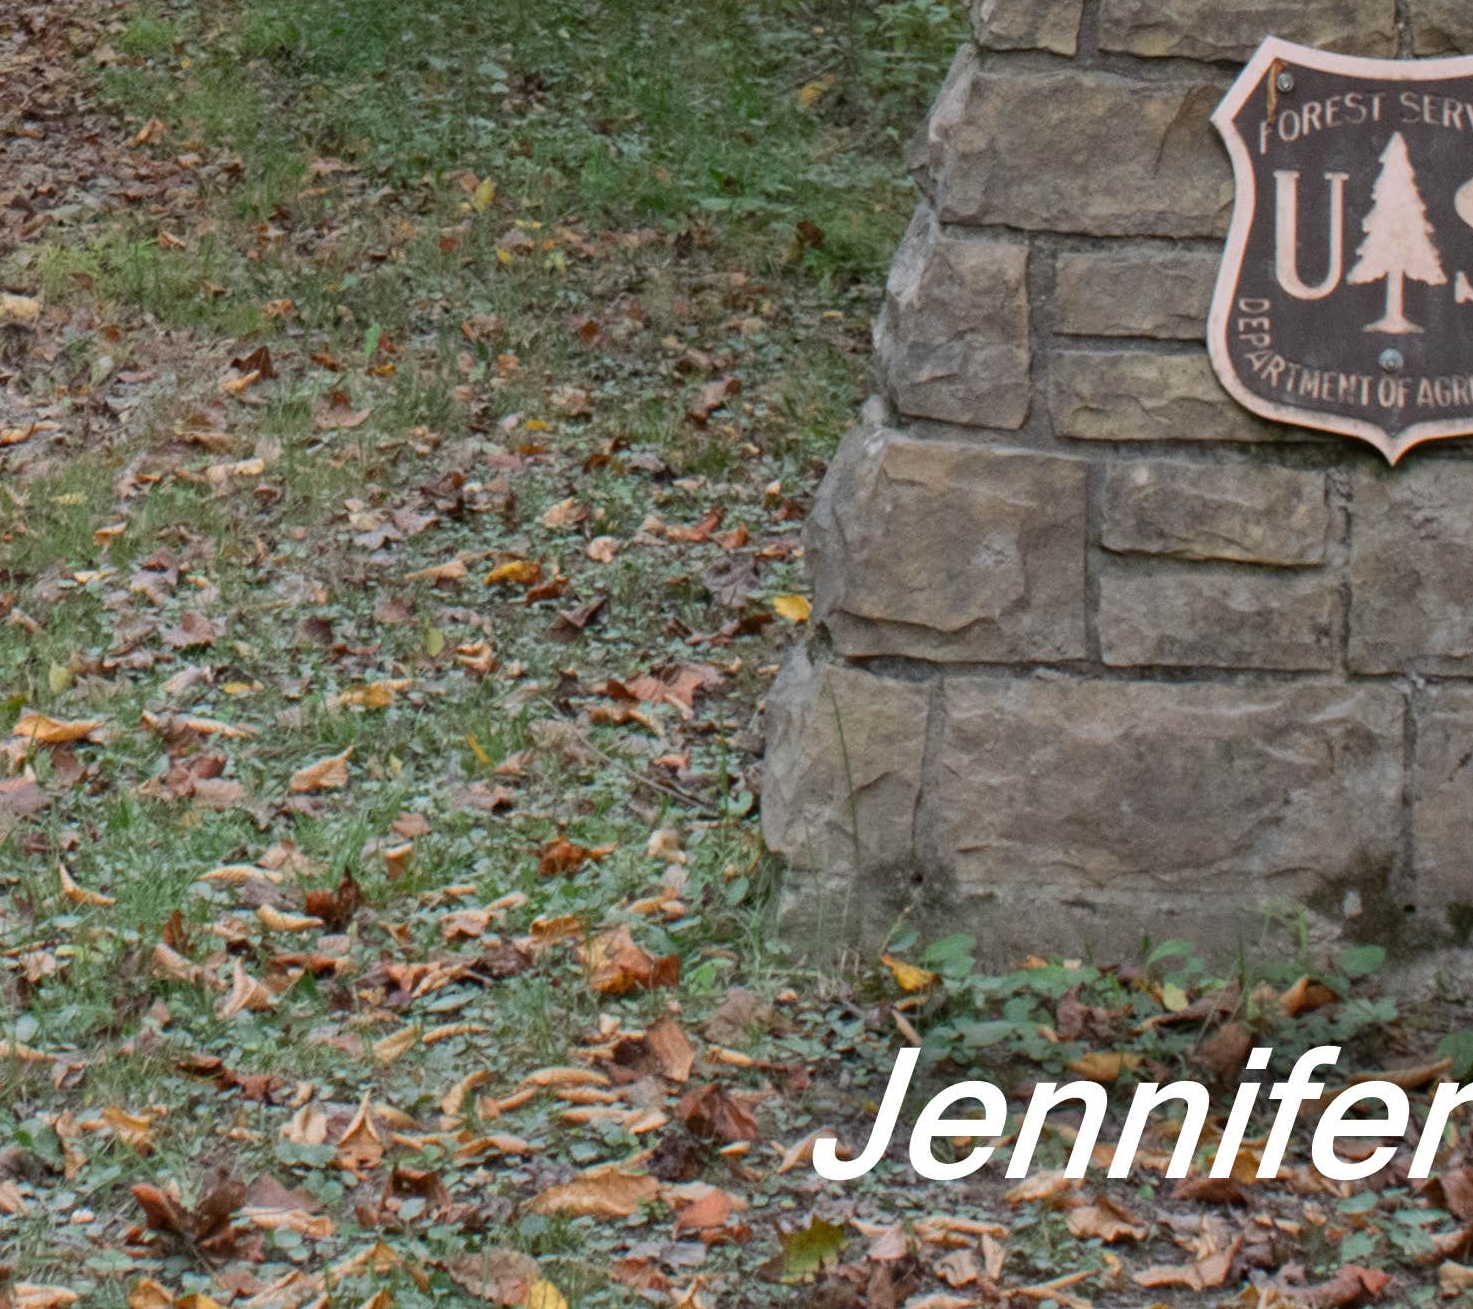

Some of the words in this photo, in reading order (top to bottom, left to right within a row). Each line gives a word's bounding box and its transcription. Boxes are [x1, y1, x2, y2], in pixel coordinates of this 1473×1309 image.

[1259, 92, 1385, 155] FOREST
[1238, 297, 1373, 406] DEPARTMENT
[1377, 377, 1406, 408] OF
